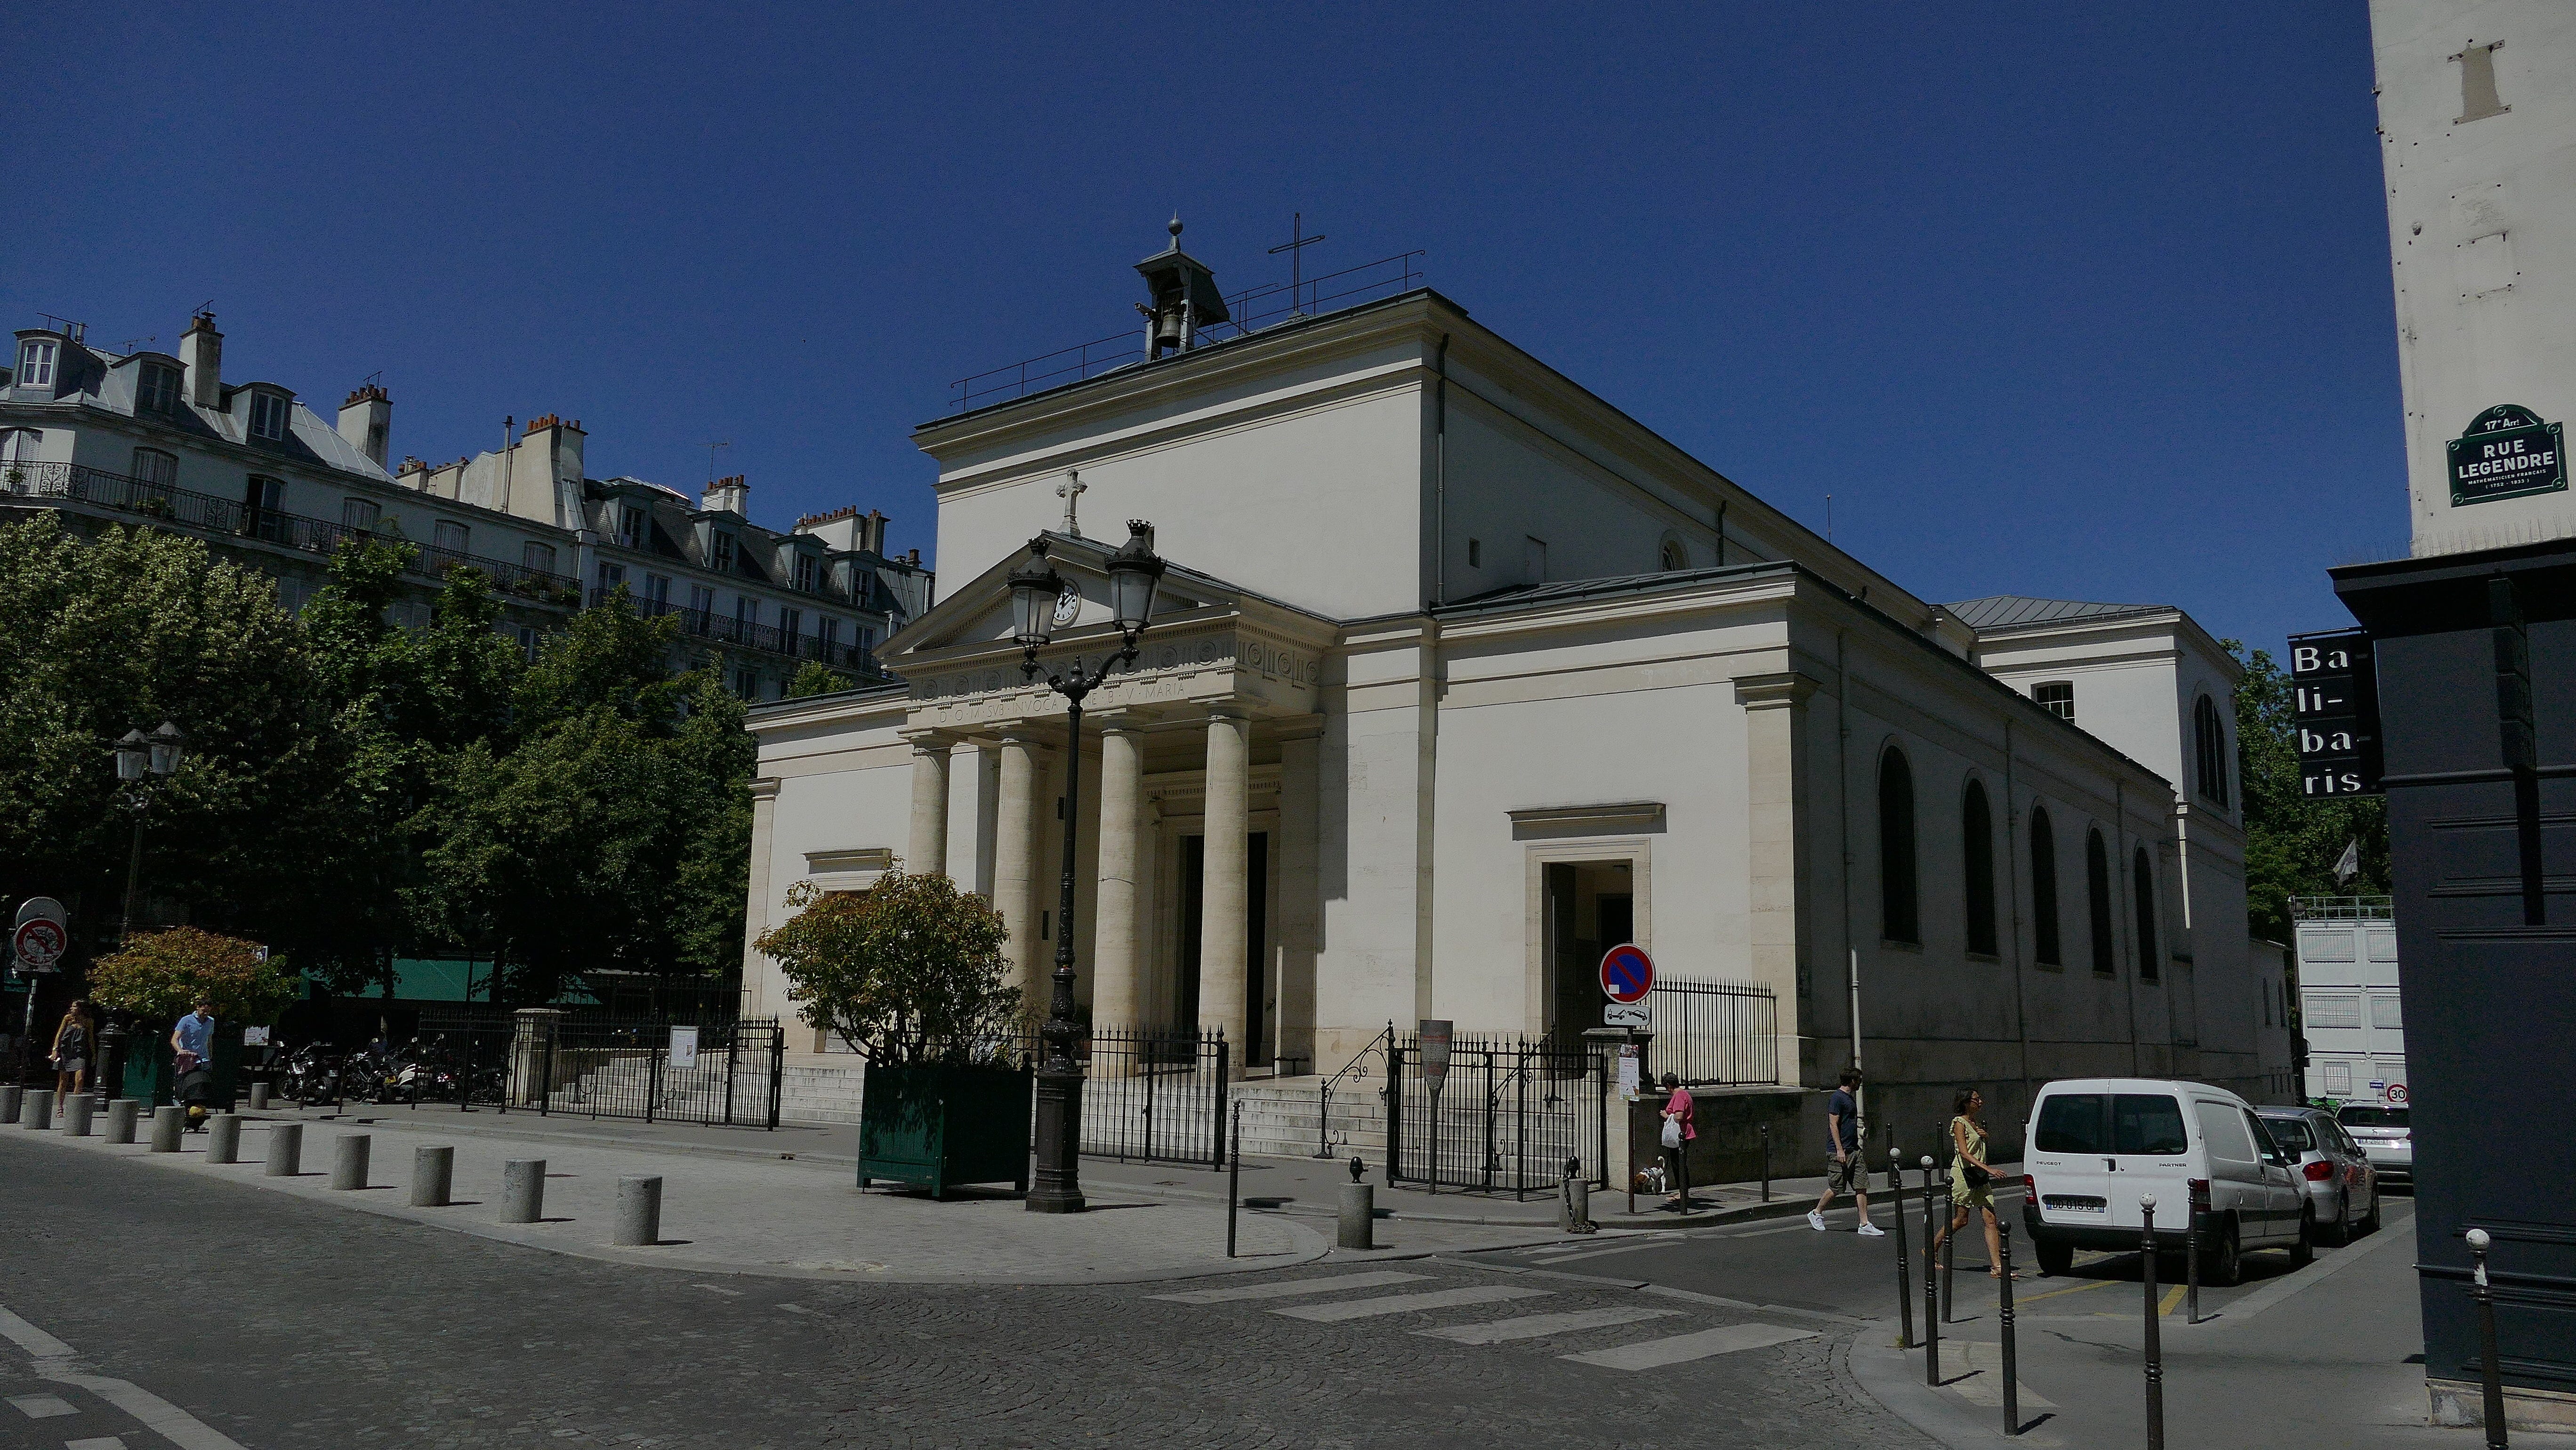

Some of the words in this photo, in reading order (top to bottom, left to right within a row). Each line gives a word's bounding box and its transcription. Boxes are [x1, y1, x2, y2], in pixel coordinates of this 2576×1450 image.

[2484, 439, 2525, 458] RUE
[2458, 451, 2555, 479] LEGENDRE
[2517, 468, 2546, 477] FRANÇAIS
[2294, 647, 2348, 672] Ba
[2297, 686, 2343, 712] li-
[2301, 728, 2351, 752] ba
[2305, 768, 2361, 794] ris
[2391, 1089, 2406, 1099] 30
